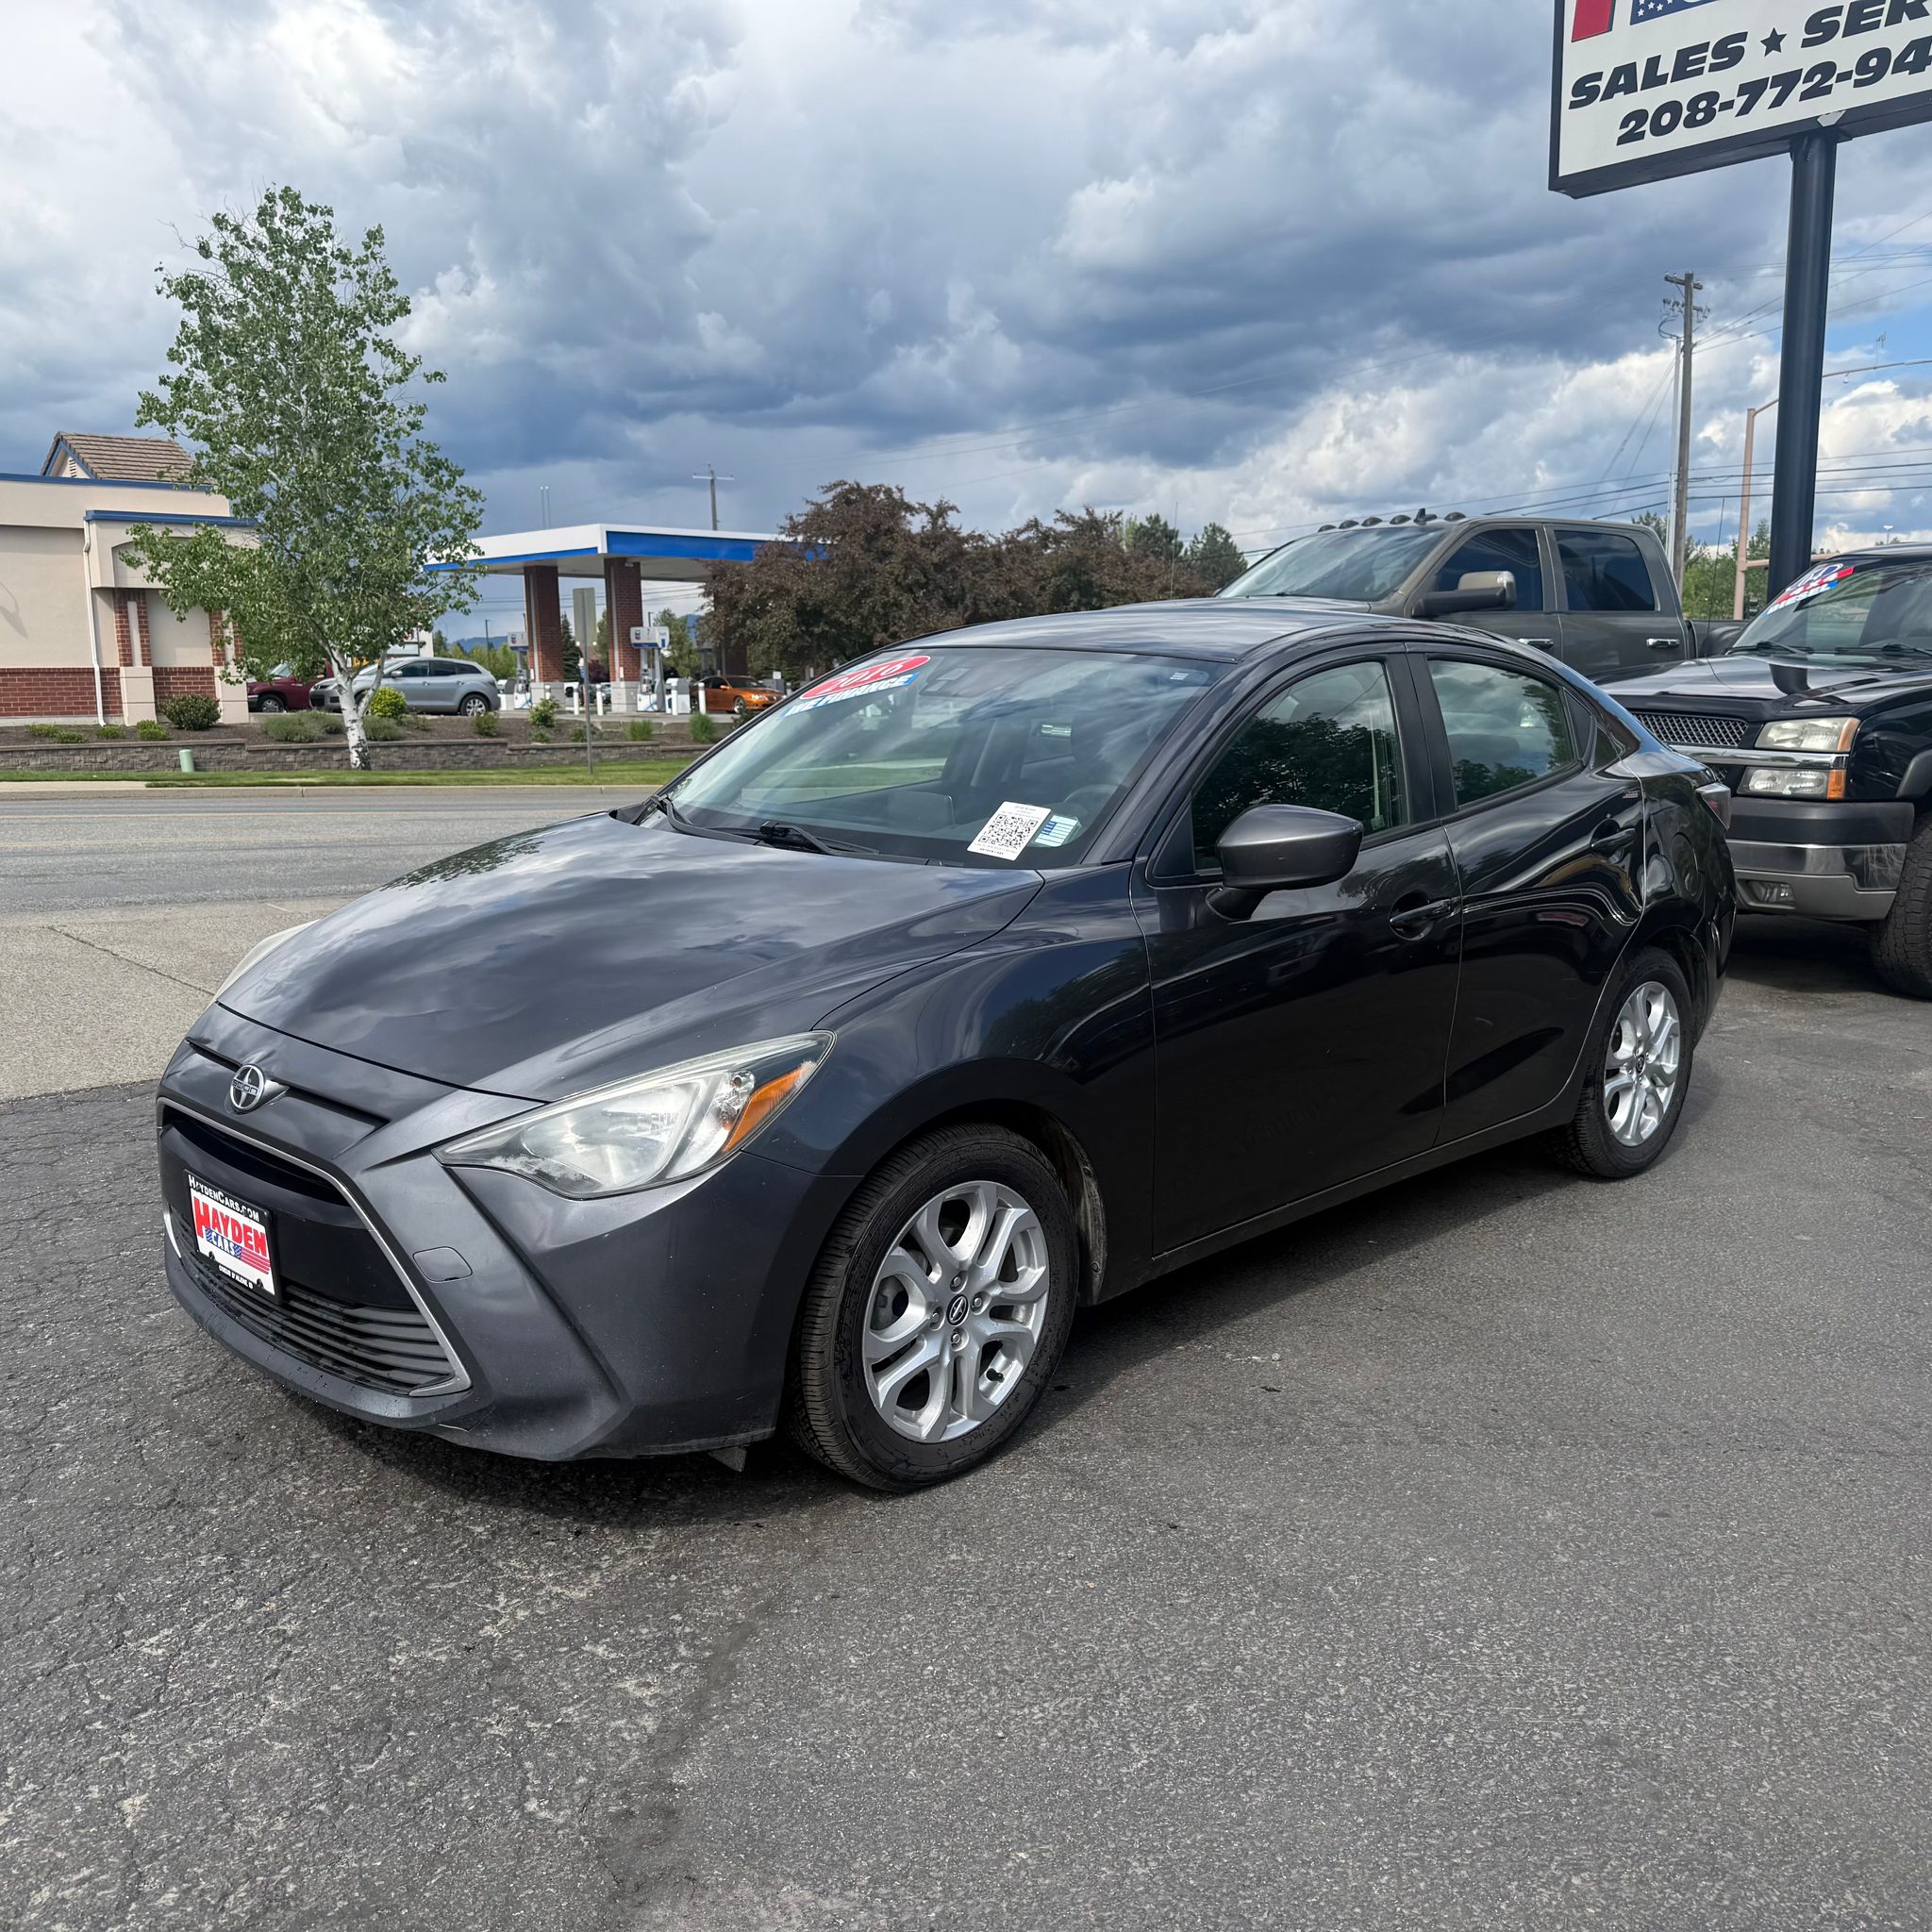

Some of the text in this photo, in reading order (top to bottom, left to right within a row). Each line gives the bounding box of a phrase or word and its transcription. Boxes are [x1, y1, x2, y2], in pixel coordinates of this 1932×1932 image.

[1568, 31, 1748, 110] SALES
[1616, 35, 1932, 146] 208-772-94
[816, 658, 912, 696] 2016
[193, 1196, 267, 1257] HAYDEN
[211, 1231, 236, 1256] CARS
